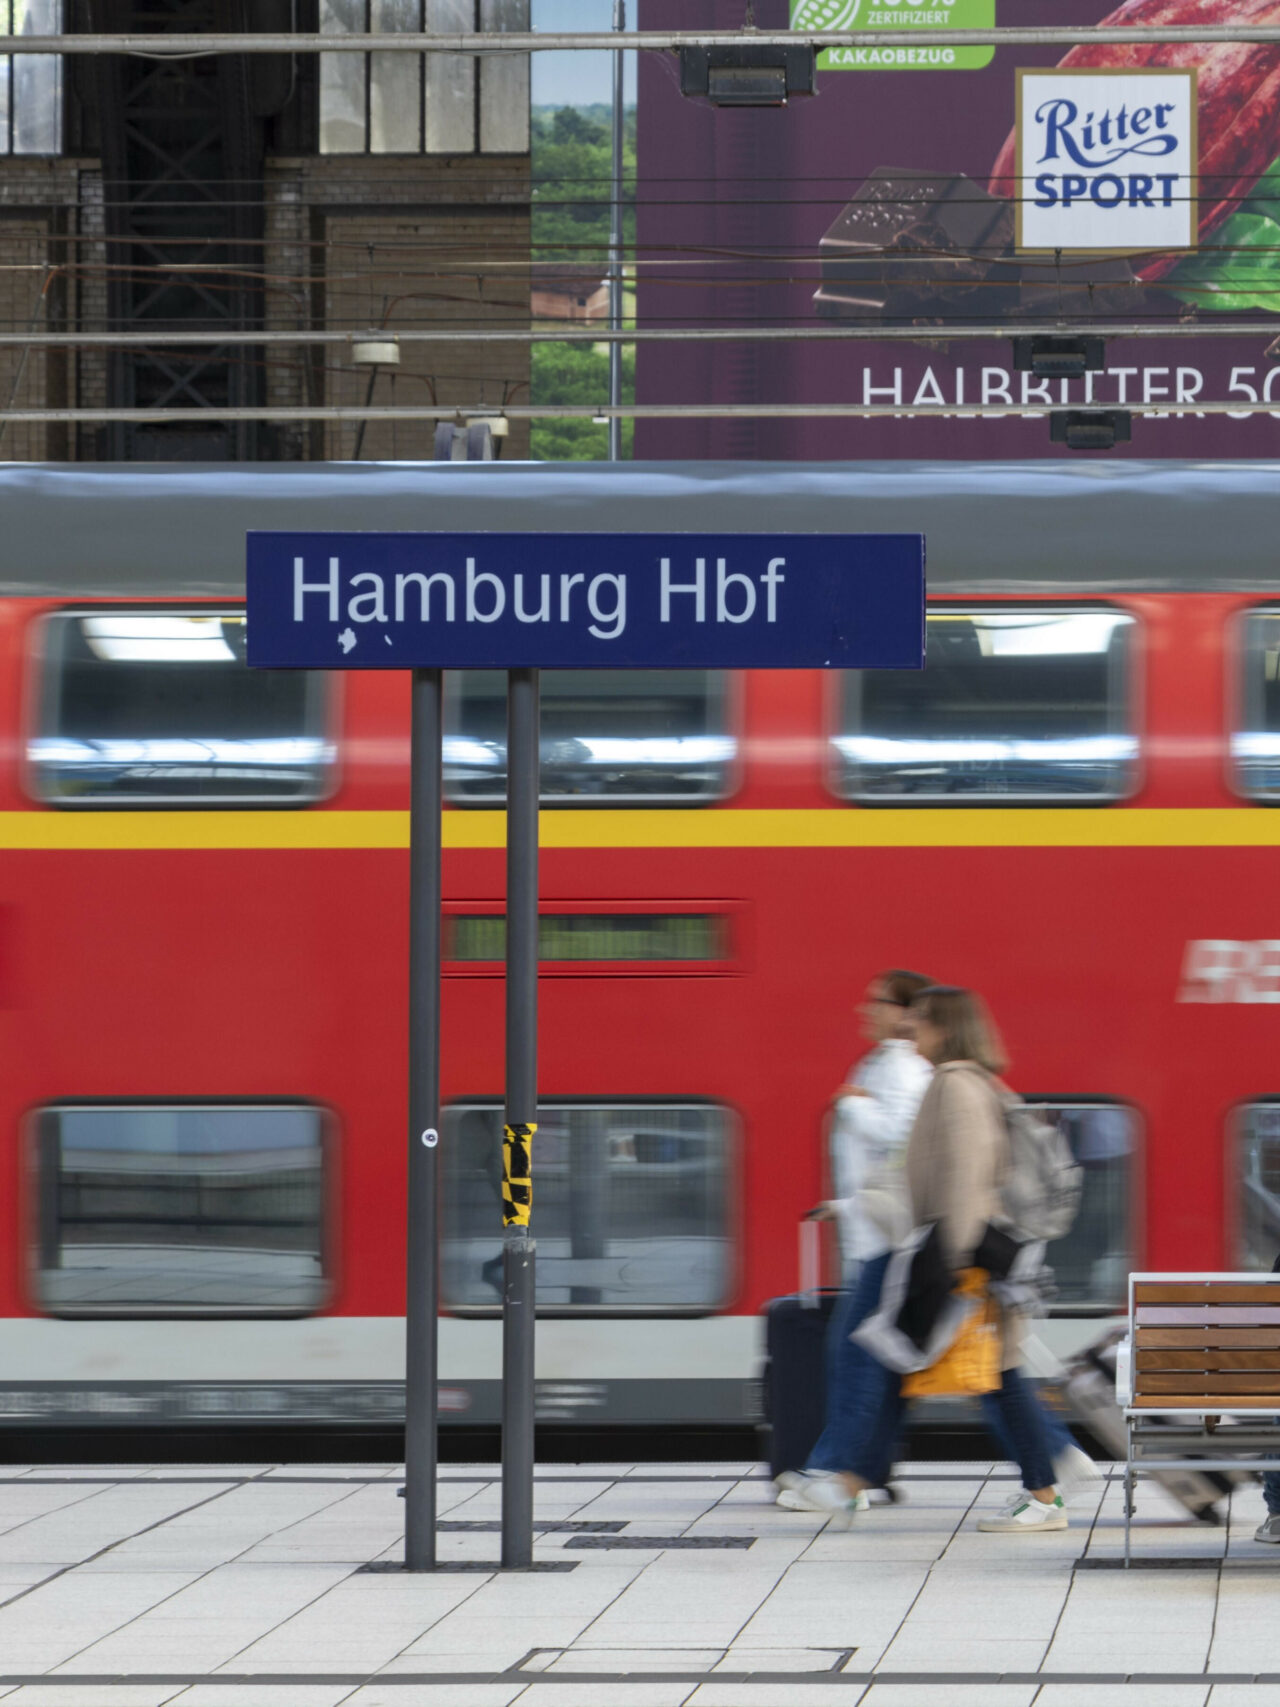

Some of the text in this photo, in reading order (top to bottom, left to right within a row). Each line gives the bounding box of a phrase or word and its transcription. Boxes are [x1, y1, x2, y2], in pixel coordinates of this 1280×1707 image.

[867, 10, 950, 25] ZERTIFIZIERT
[829, 48, 956, 64] KAKAOBEZUG
[1035, 98, 1179, 169] Ritter
[1034, 172, 1179, 209] SPORT
[292, 556, 786, 640] Hamburg Hbf
